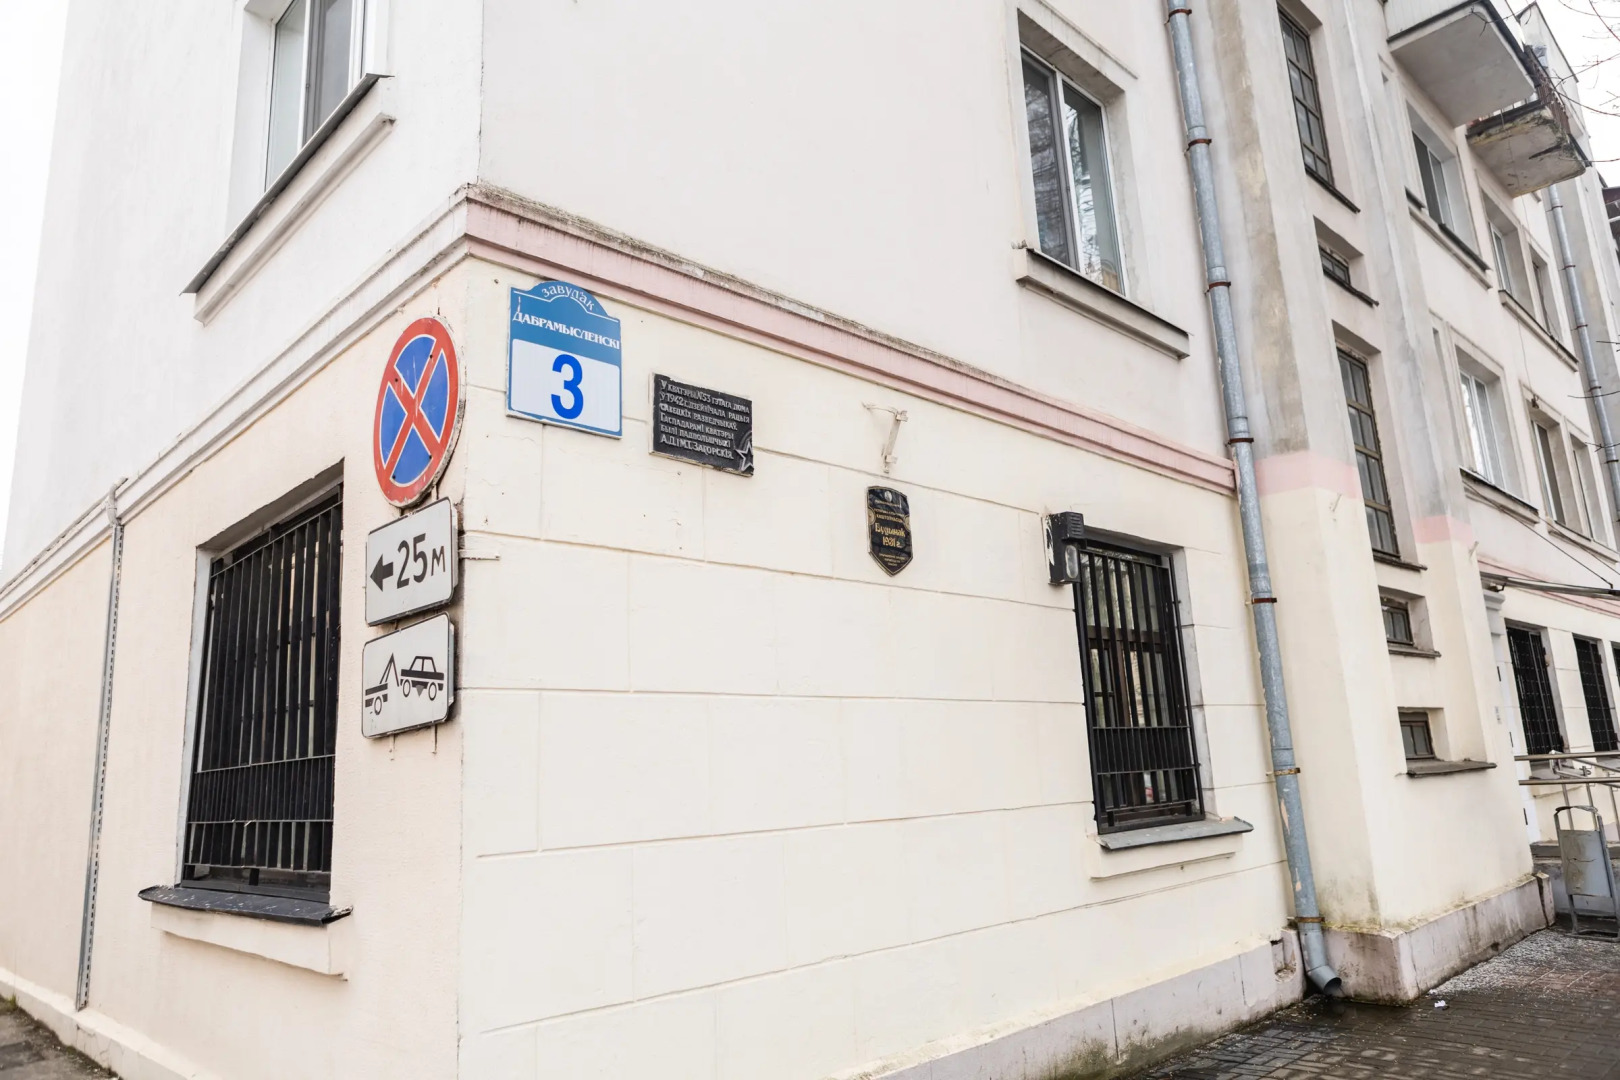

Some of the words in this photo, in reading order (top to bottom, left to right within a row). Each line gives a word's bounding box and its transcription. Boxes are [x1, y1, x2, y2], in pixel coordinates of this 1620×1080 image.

[541, 285, 595, 311] завулак
[512, 304, 620, 350] ДАБРАМЫСЛЕНСКІ
[550, 353, 584, 420] 3
